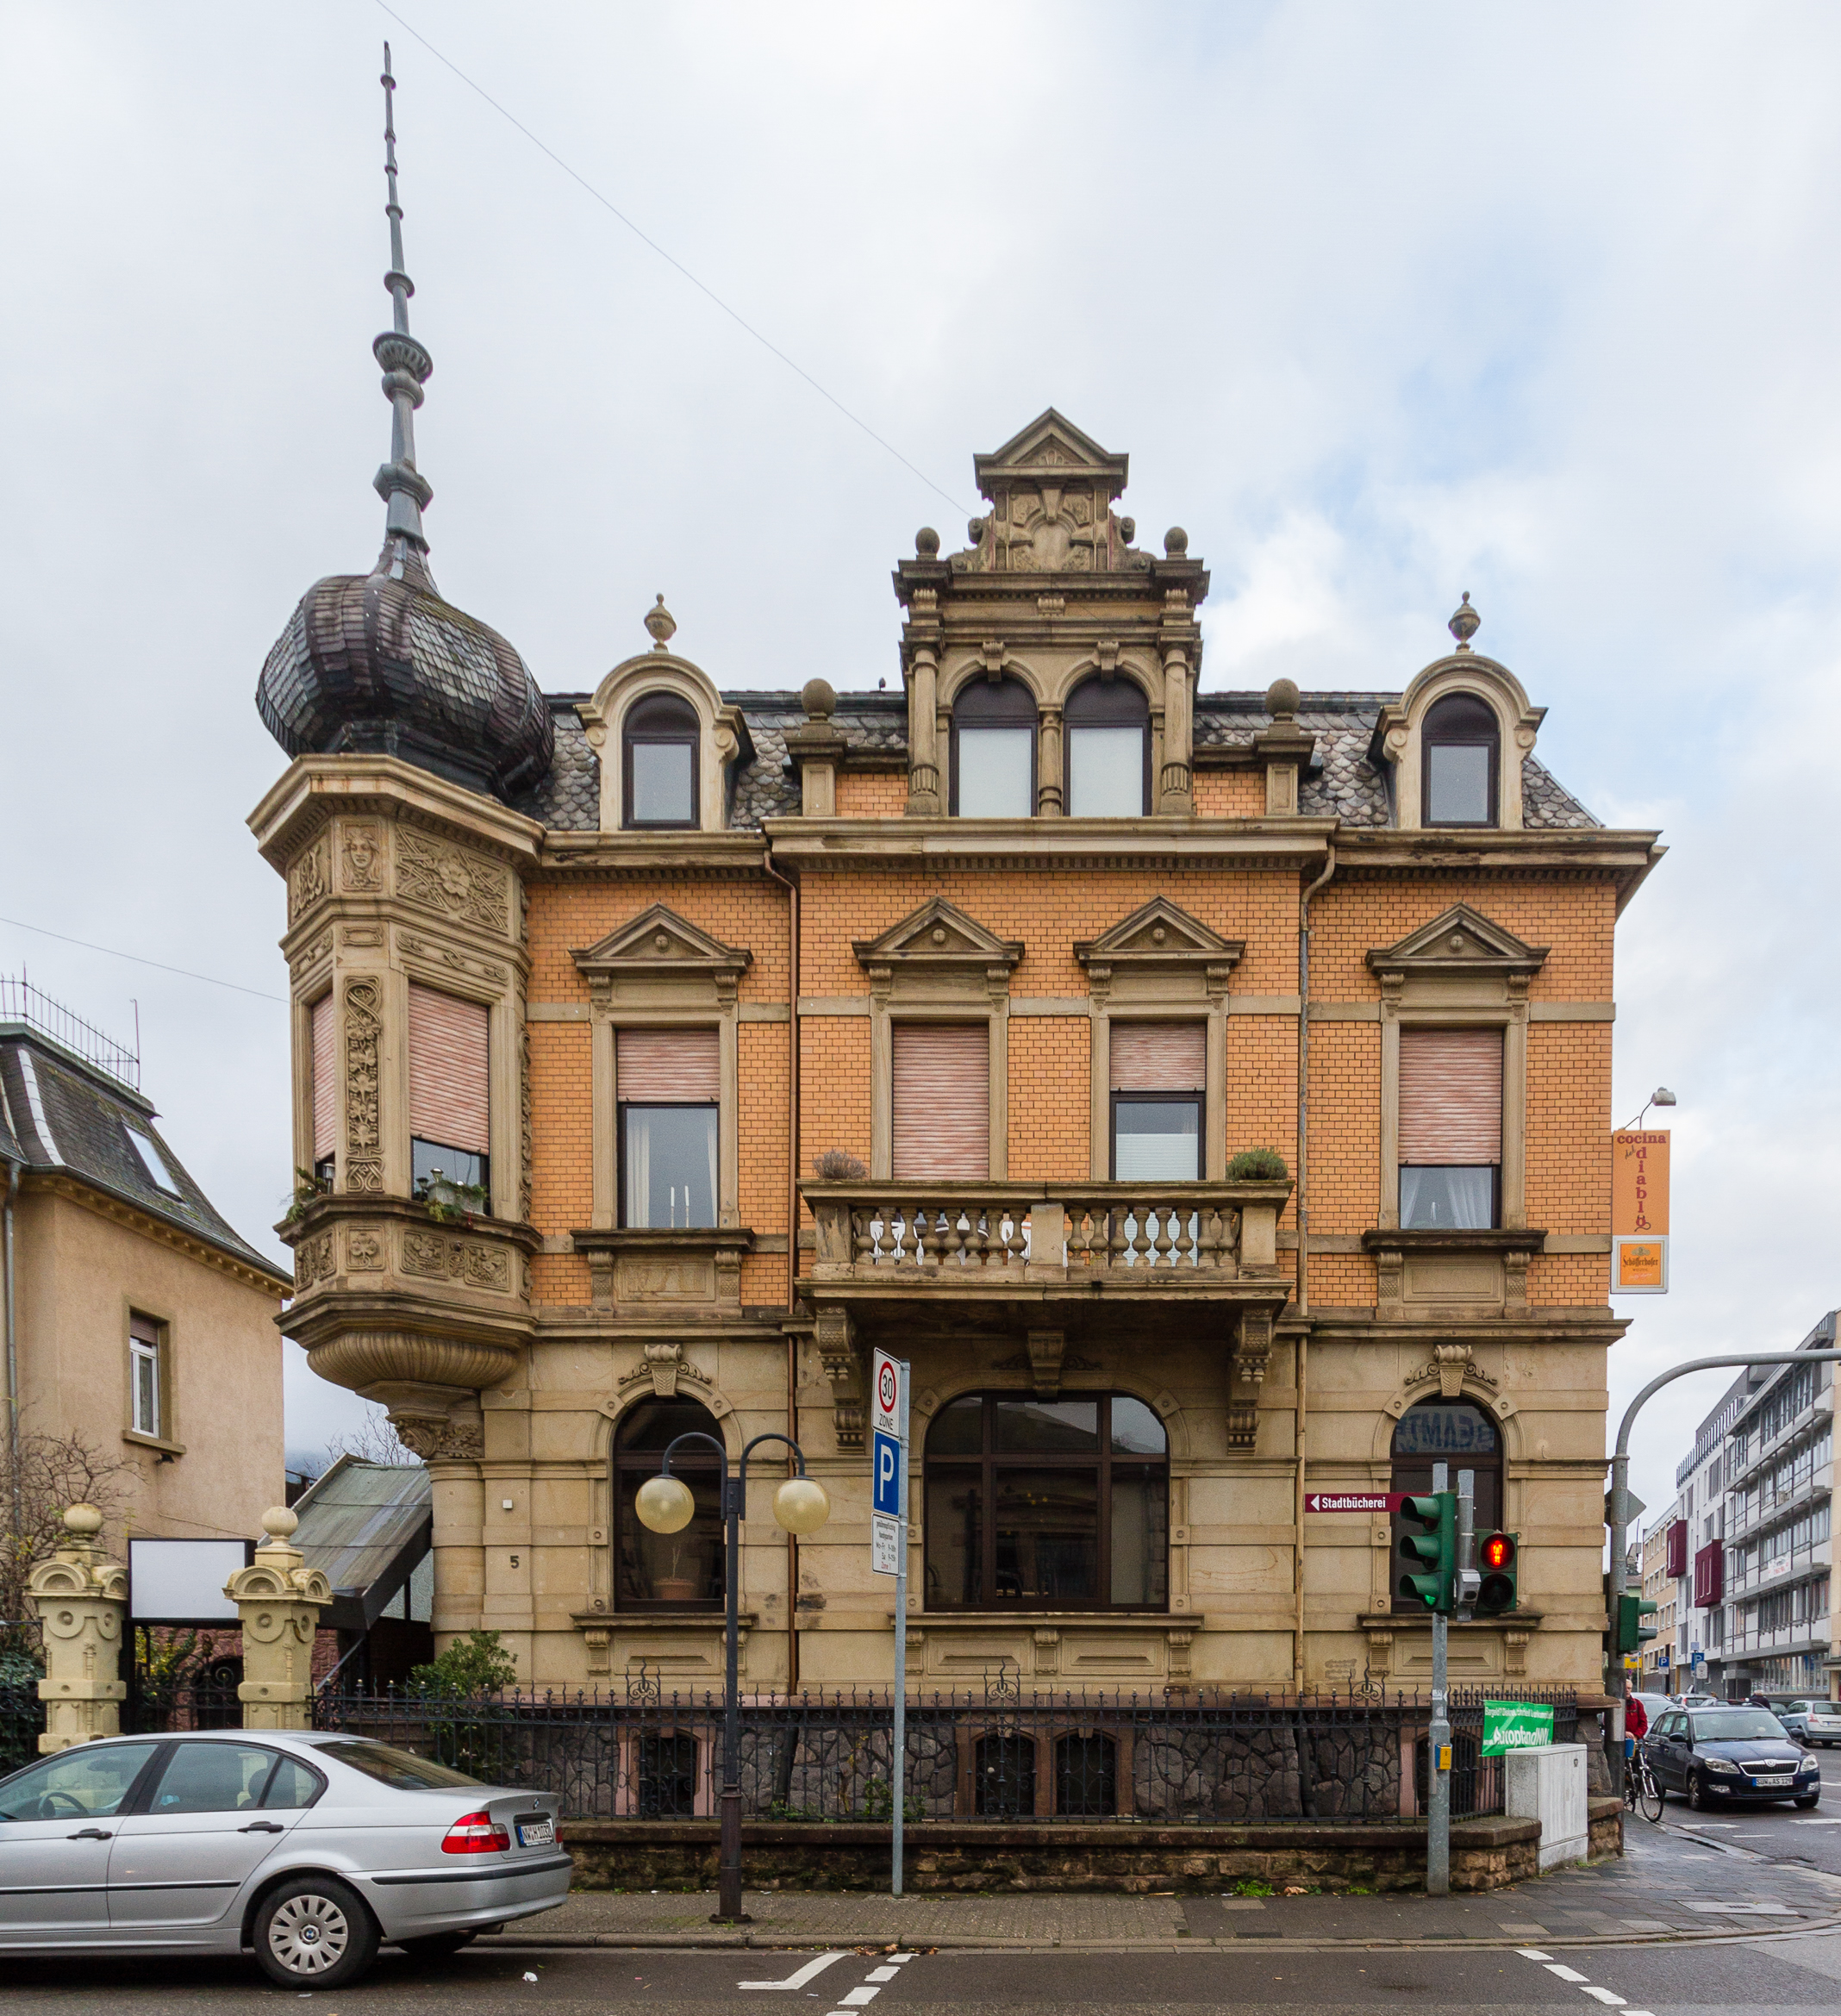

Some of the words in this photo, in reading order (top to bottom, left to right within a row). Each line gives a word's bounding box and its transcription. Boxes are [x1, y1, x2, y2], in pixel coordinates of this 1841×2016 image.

[1617, 1132, 1666, 1144] cocina
[1636, 1147, 1647, 1227] diablo
[883, 1375, 893, 1400] 30
[879, 1414, 894, 1430] ZONE
[880, 1444, 894, 1501] P
[1322, 1496, 1386, 1508] Stadtbücherei
[510, 1555, 519, 1569] 5
